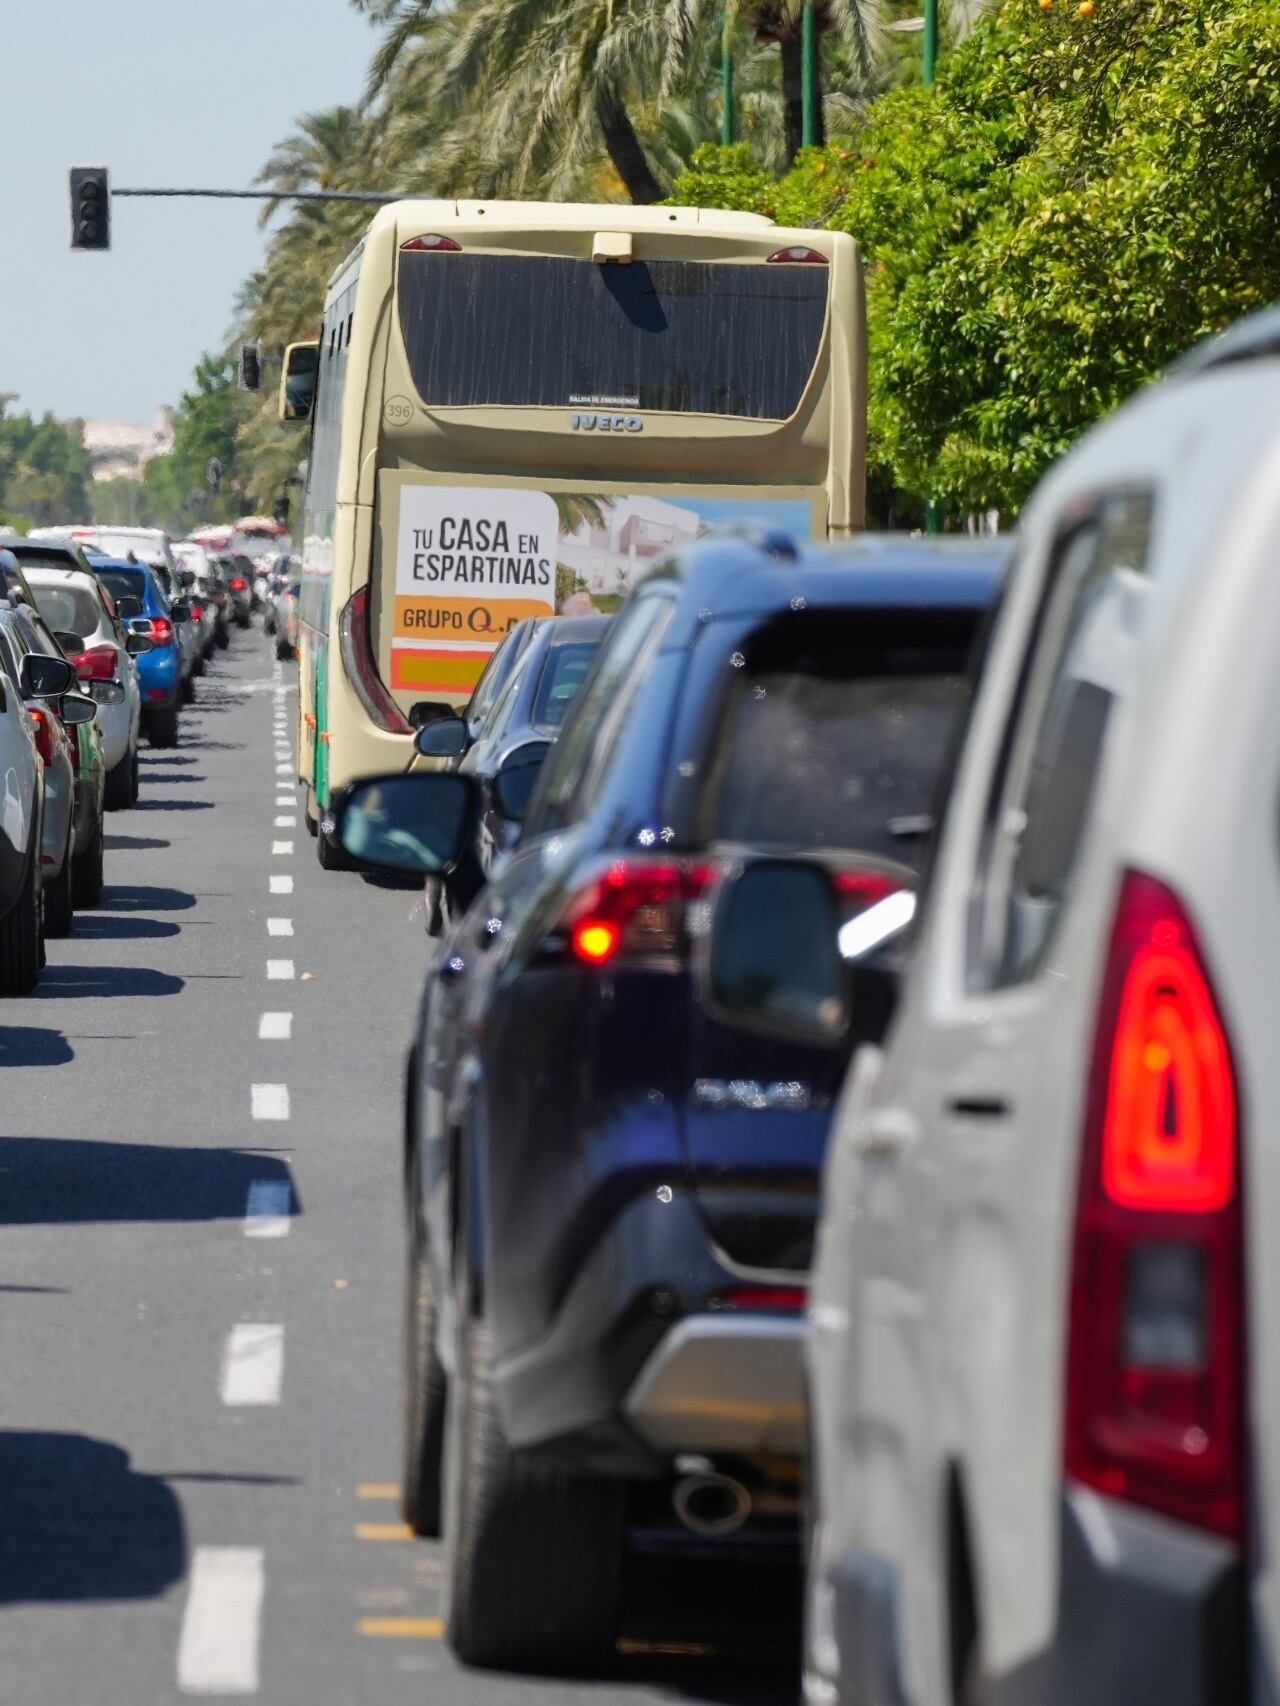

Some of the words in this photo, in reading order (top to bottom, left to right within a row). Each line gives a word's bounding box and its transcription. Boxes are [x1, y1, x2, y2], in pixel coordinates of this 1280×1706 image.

[388, 404, 410, 418] 396
[571, 414, 644, 433] IVECO
[413, 529, 433, 549] TU
[439, 517, 509, 552] CASA
[519, 534, 539, 554] EN
[413, 553, 550, 585] ESPARTINAS
[403, 608, 463, 629] GRUPO
